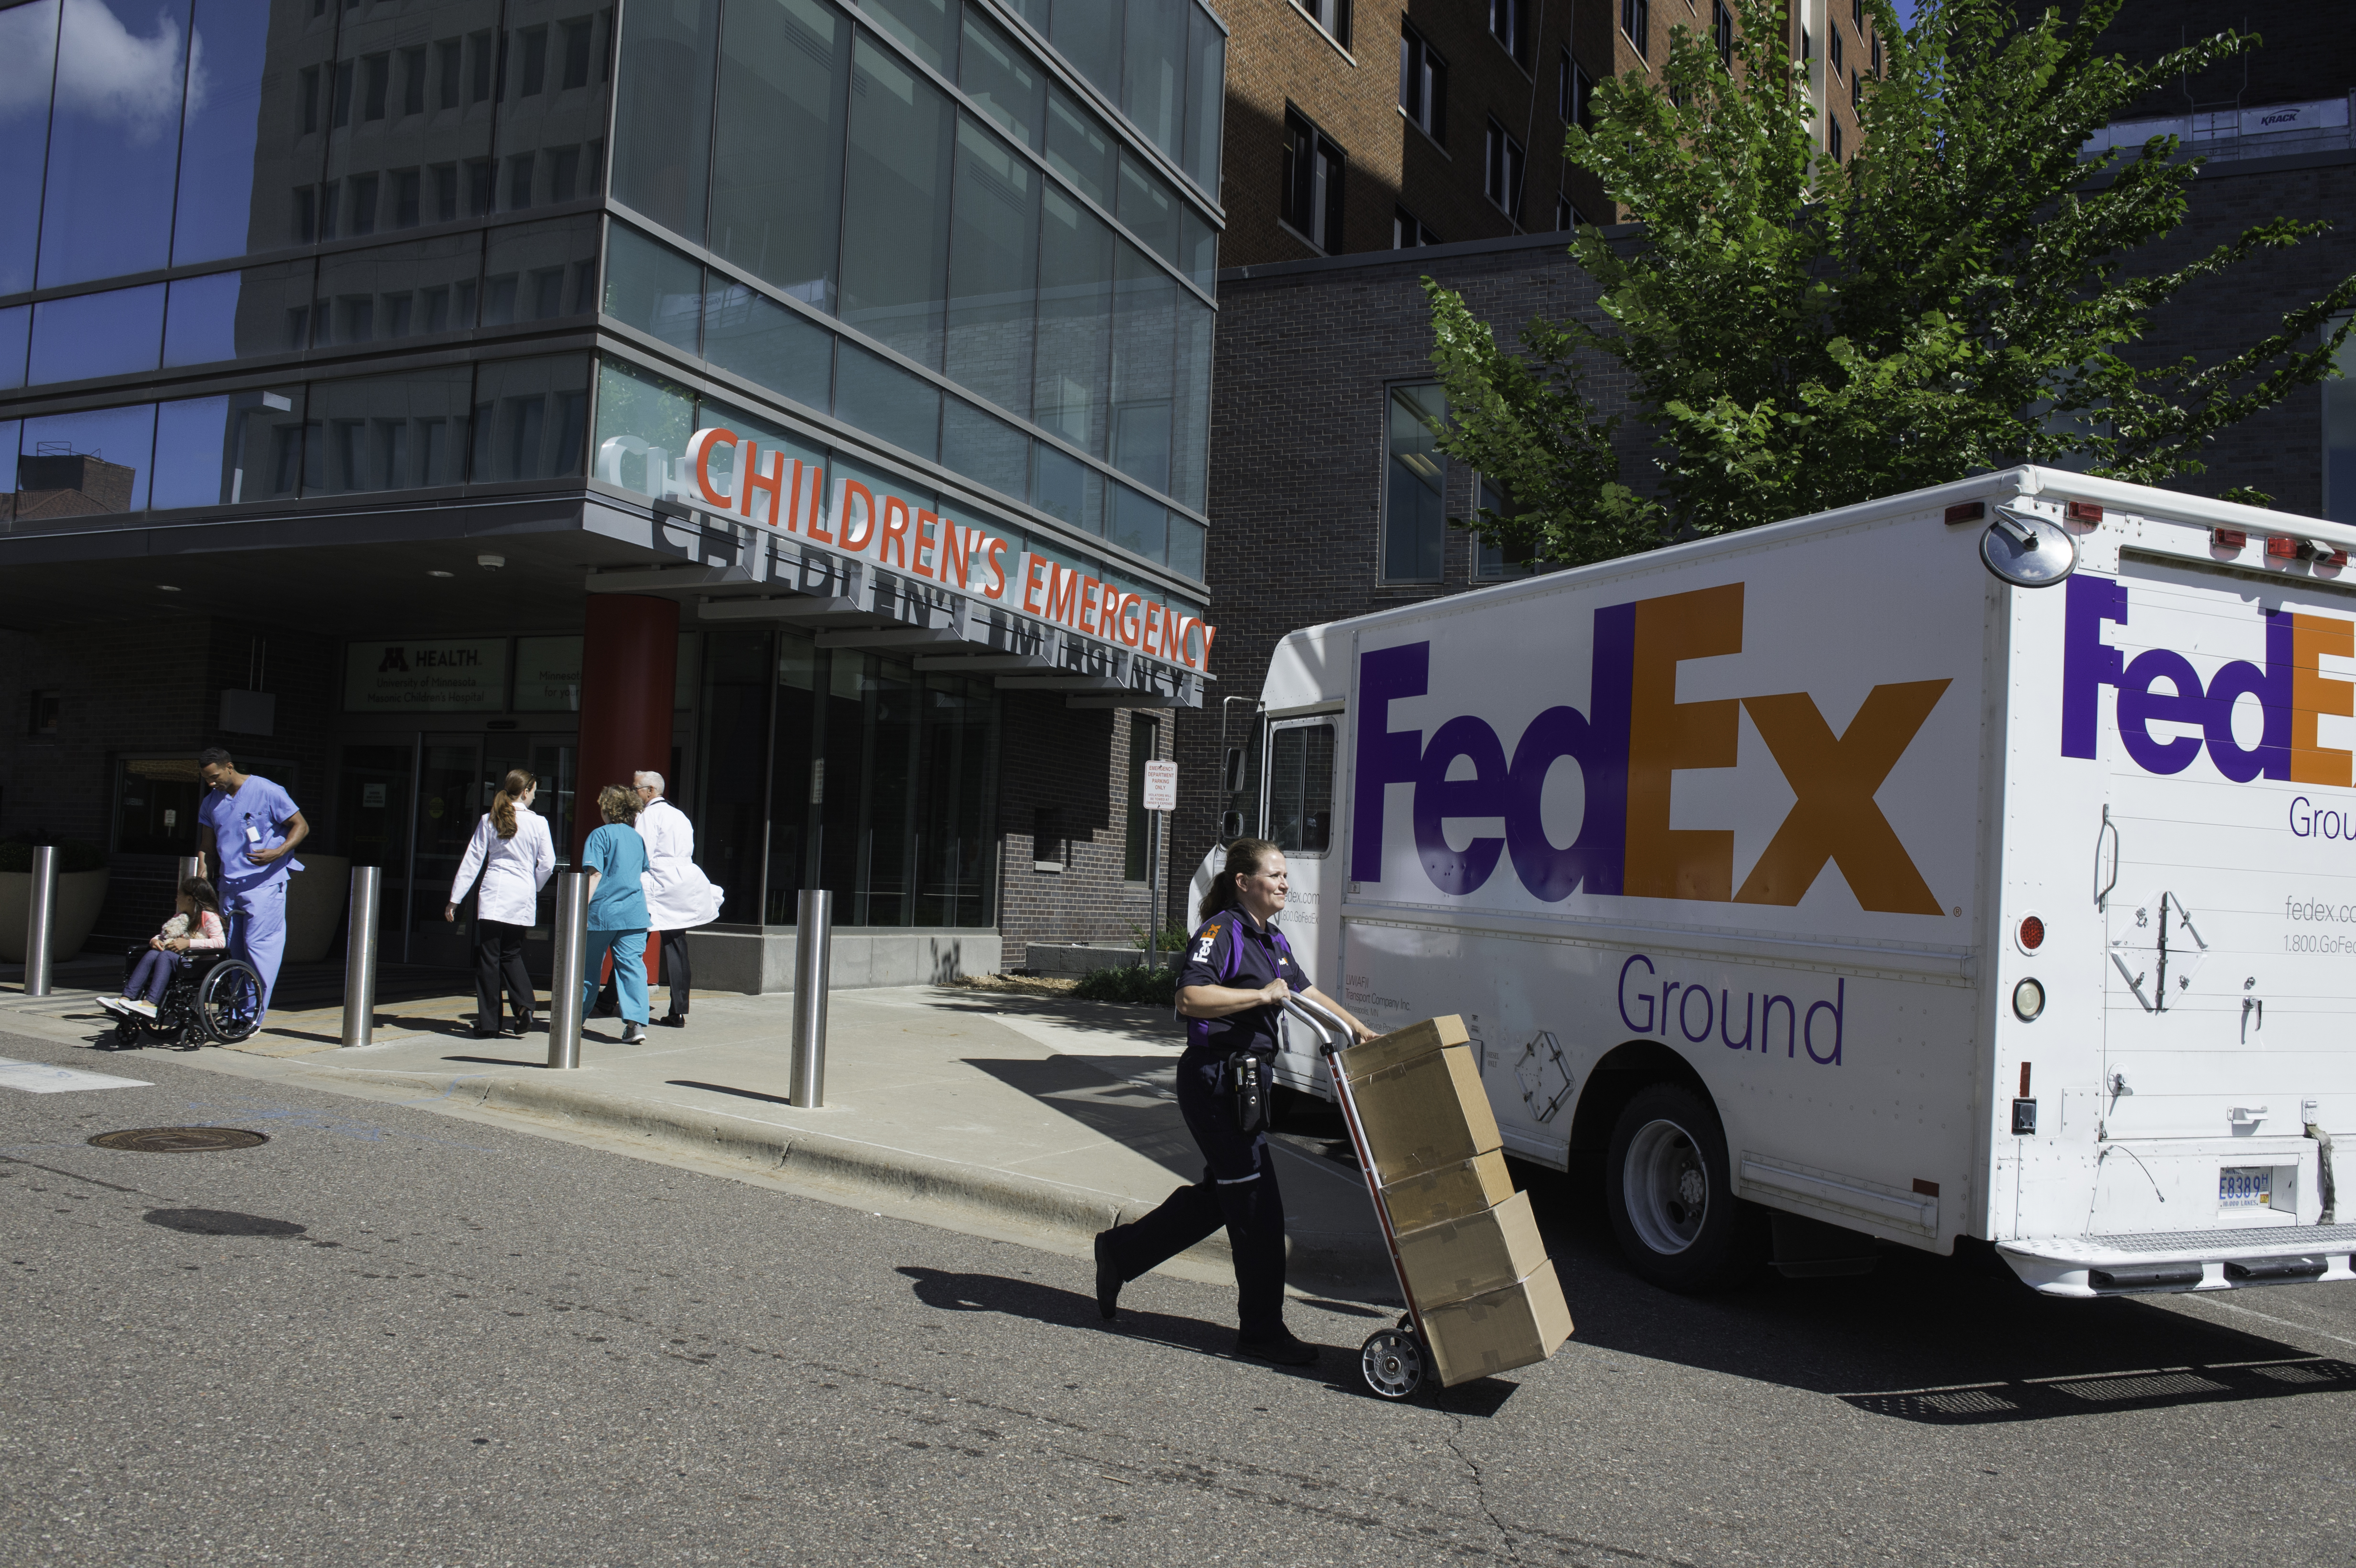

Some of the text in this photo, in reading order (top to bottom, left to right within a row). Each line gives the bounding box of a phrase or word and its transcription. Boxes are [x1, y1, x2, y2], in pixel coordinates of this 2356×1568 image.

[2261, 113, 2297, 126] KRACK
[685, 428, 1216, 672] CHILDREN'S EMERGENCY
[416, 650, 478, 666] HEALTH
[377, 676, 476, 689] University of Minnesota
[2061, 574, 2356, 788] FedE
[368, 691, 484, 704] Masonic Children's Hospital
[545, 686, 557, 697] for
[1351, 582, 1953, 916] FedEx
[1285, 887, 1320, 905] edex.com
[1280, 909, 1319, 924] 1.800.GoFedEx
[1192, 924, 1222, 963] FedEx
[1345, 988, 1411, 1011] Transport Company Inc.
[1344, 1002, 1379, 1017] Minneapolis, MN
[1618, 954, 1844, 1067] Ground
[1367, 1019, 1382, 1031] Service
[1383, 1023, 1402, 1033] Provid
[1486, 1051, 1499, 1059] DIESEL
